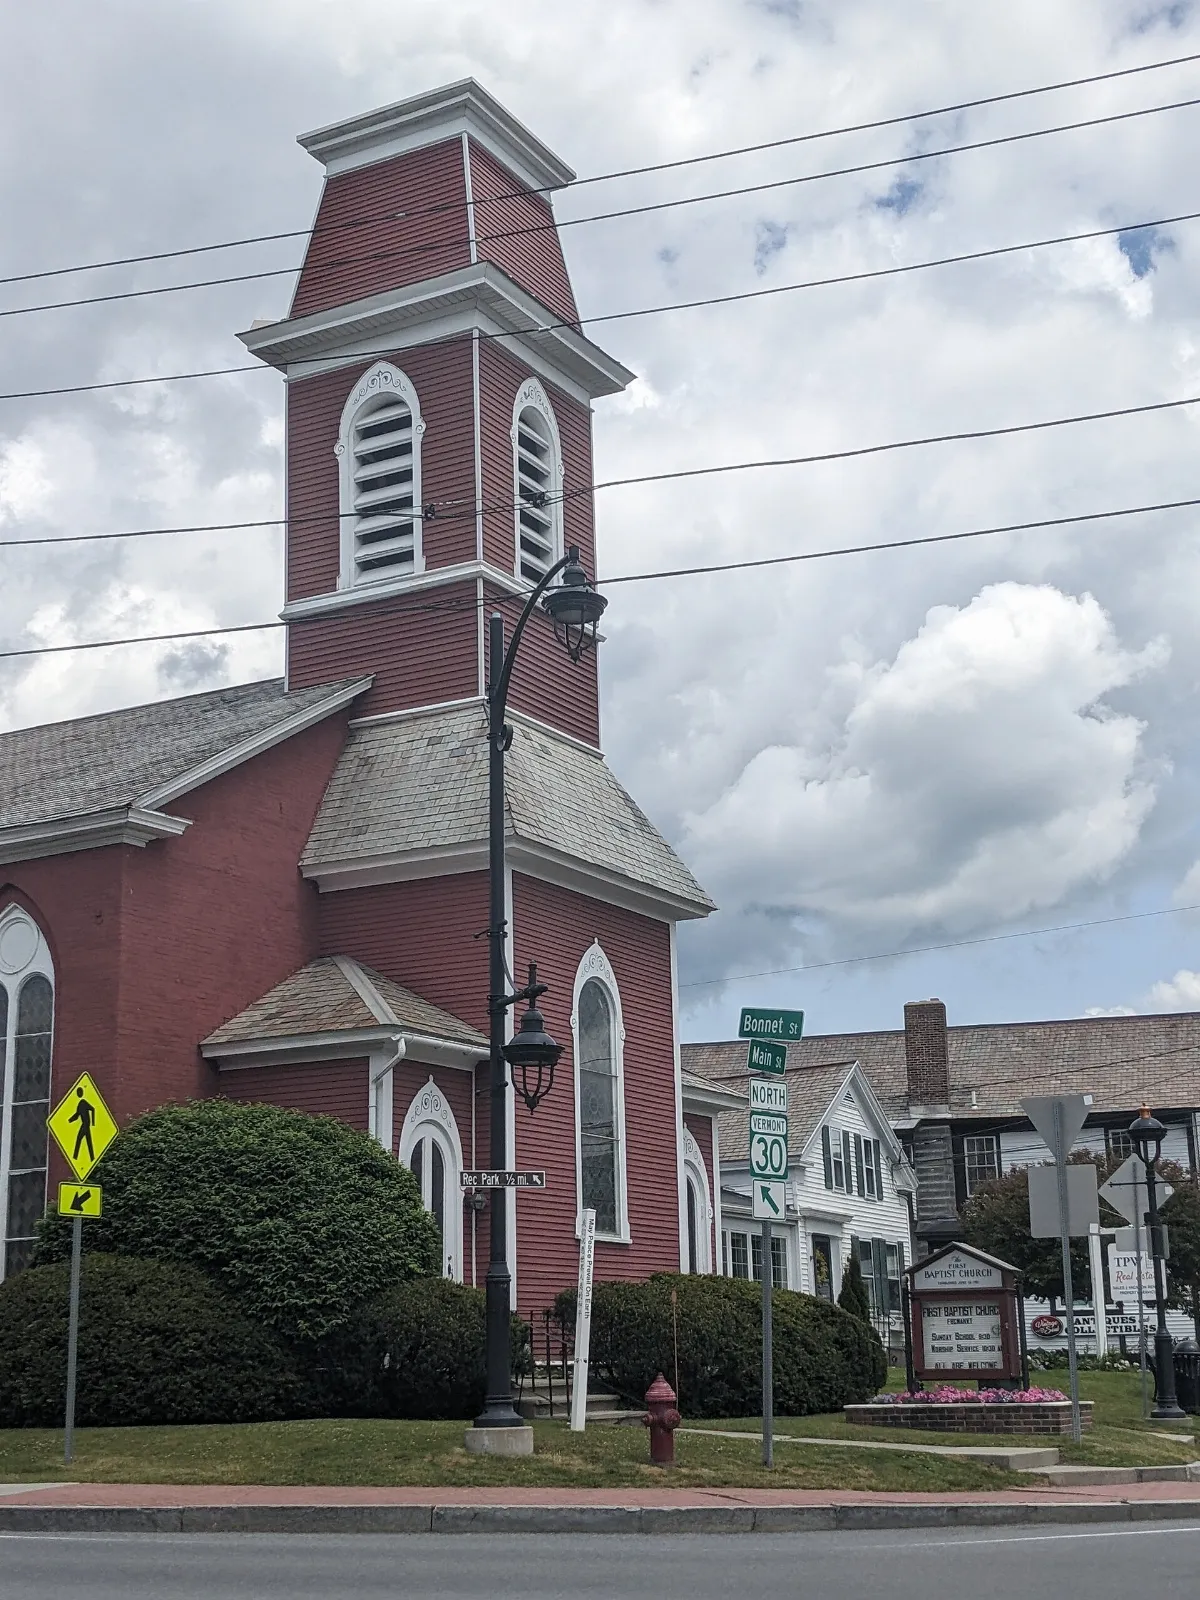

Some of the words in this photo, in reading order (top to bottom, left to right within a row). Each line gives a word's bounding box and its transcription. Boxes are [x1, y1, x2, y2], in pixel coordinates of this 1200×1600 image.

[743, 1014, 784, 1034] Bonnet
[789, 1022, 798, 1035] St
[752, 1046, 772, 1066] Main
[775, 1055, 782, 1068] St
[752, 1085, 785, 1106] NORTH
[752, 1117, 785, 1133] VERMONT
[755, 1136, 783, 1173] 30
[462, 1172, 478, 1185] Rec
[481, 1172, 500, 1185] Park
[517, 1173, 529, 1185] mi.
[587, 1218, 595, 1234] May
[586, 1235, 594, 1259] Peace
[585, 1260, 593, 1285] Prevail
[924, 1269, 956, 1279] BAPTIST
[958, 1268, 992, 1278] CHURCH
[1115, 1270, 1134, 1283] Real
[585, 1286, 592, 1297] On
[922, 1307, 942, 1318] FIRST
[944, 1306, 974, 1317] BAPTIST
